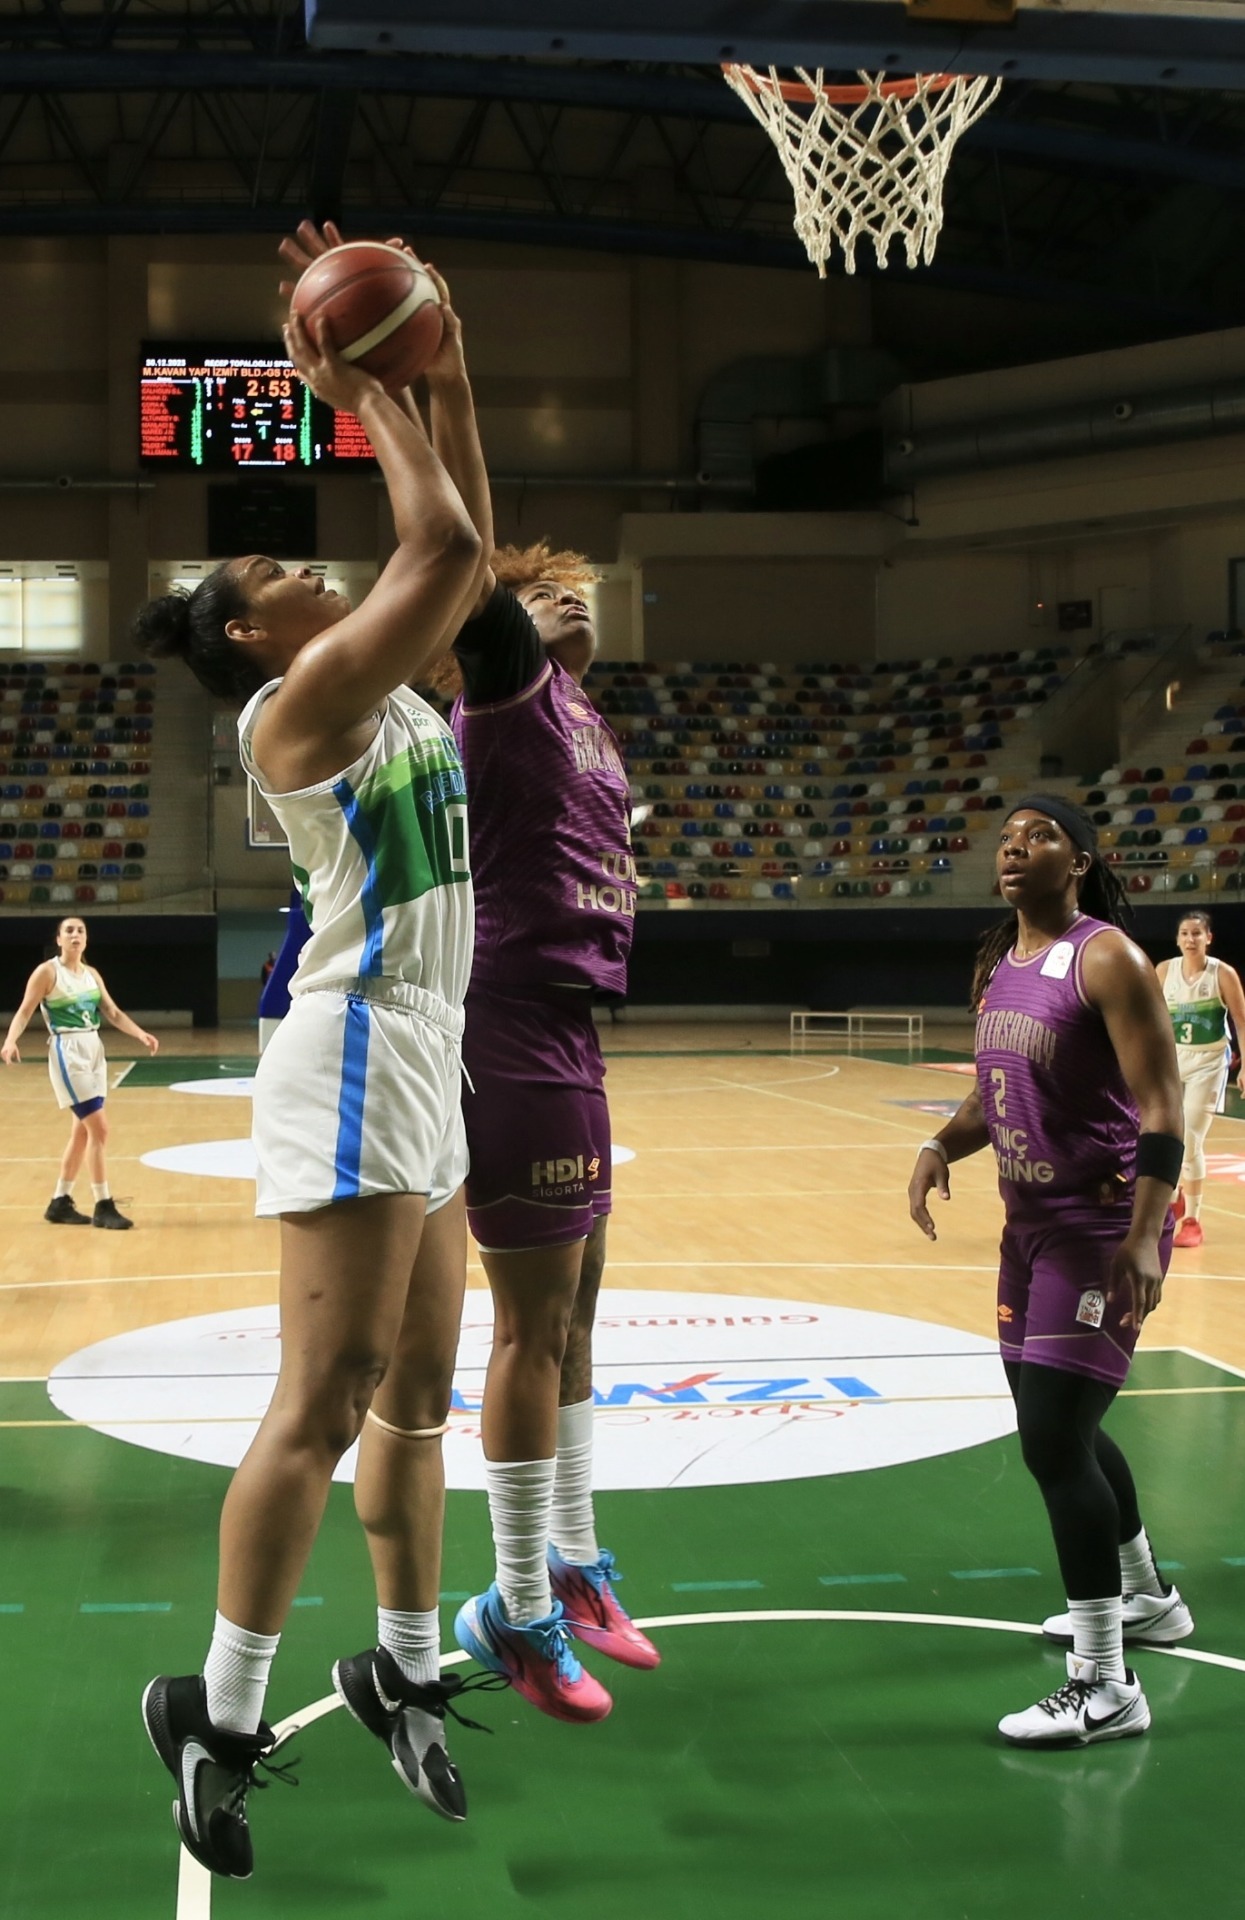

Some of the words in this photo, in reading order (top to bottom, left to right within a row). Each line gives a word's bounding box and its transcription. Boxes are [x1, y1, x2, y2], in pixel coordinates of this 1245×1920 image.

[142, 367, 186, 376] M.KAVAN
[188, 367, 210, 377] YAPI
[233, 405, 246, 419] 3
[281, 405, 294, 419] 2
[257, 425, 267, 440] 1
[231, 445, 254, 460] 17
[272, 445, 297, 461] 18
[1180, 1023, 1193, 1044] 3
[991, 1068, 1006, 1118] 2
[531, 1154, 584, 1186] HDI
